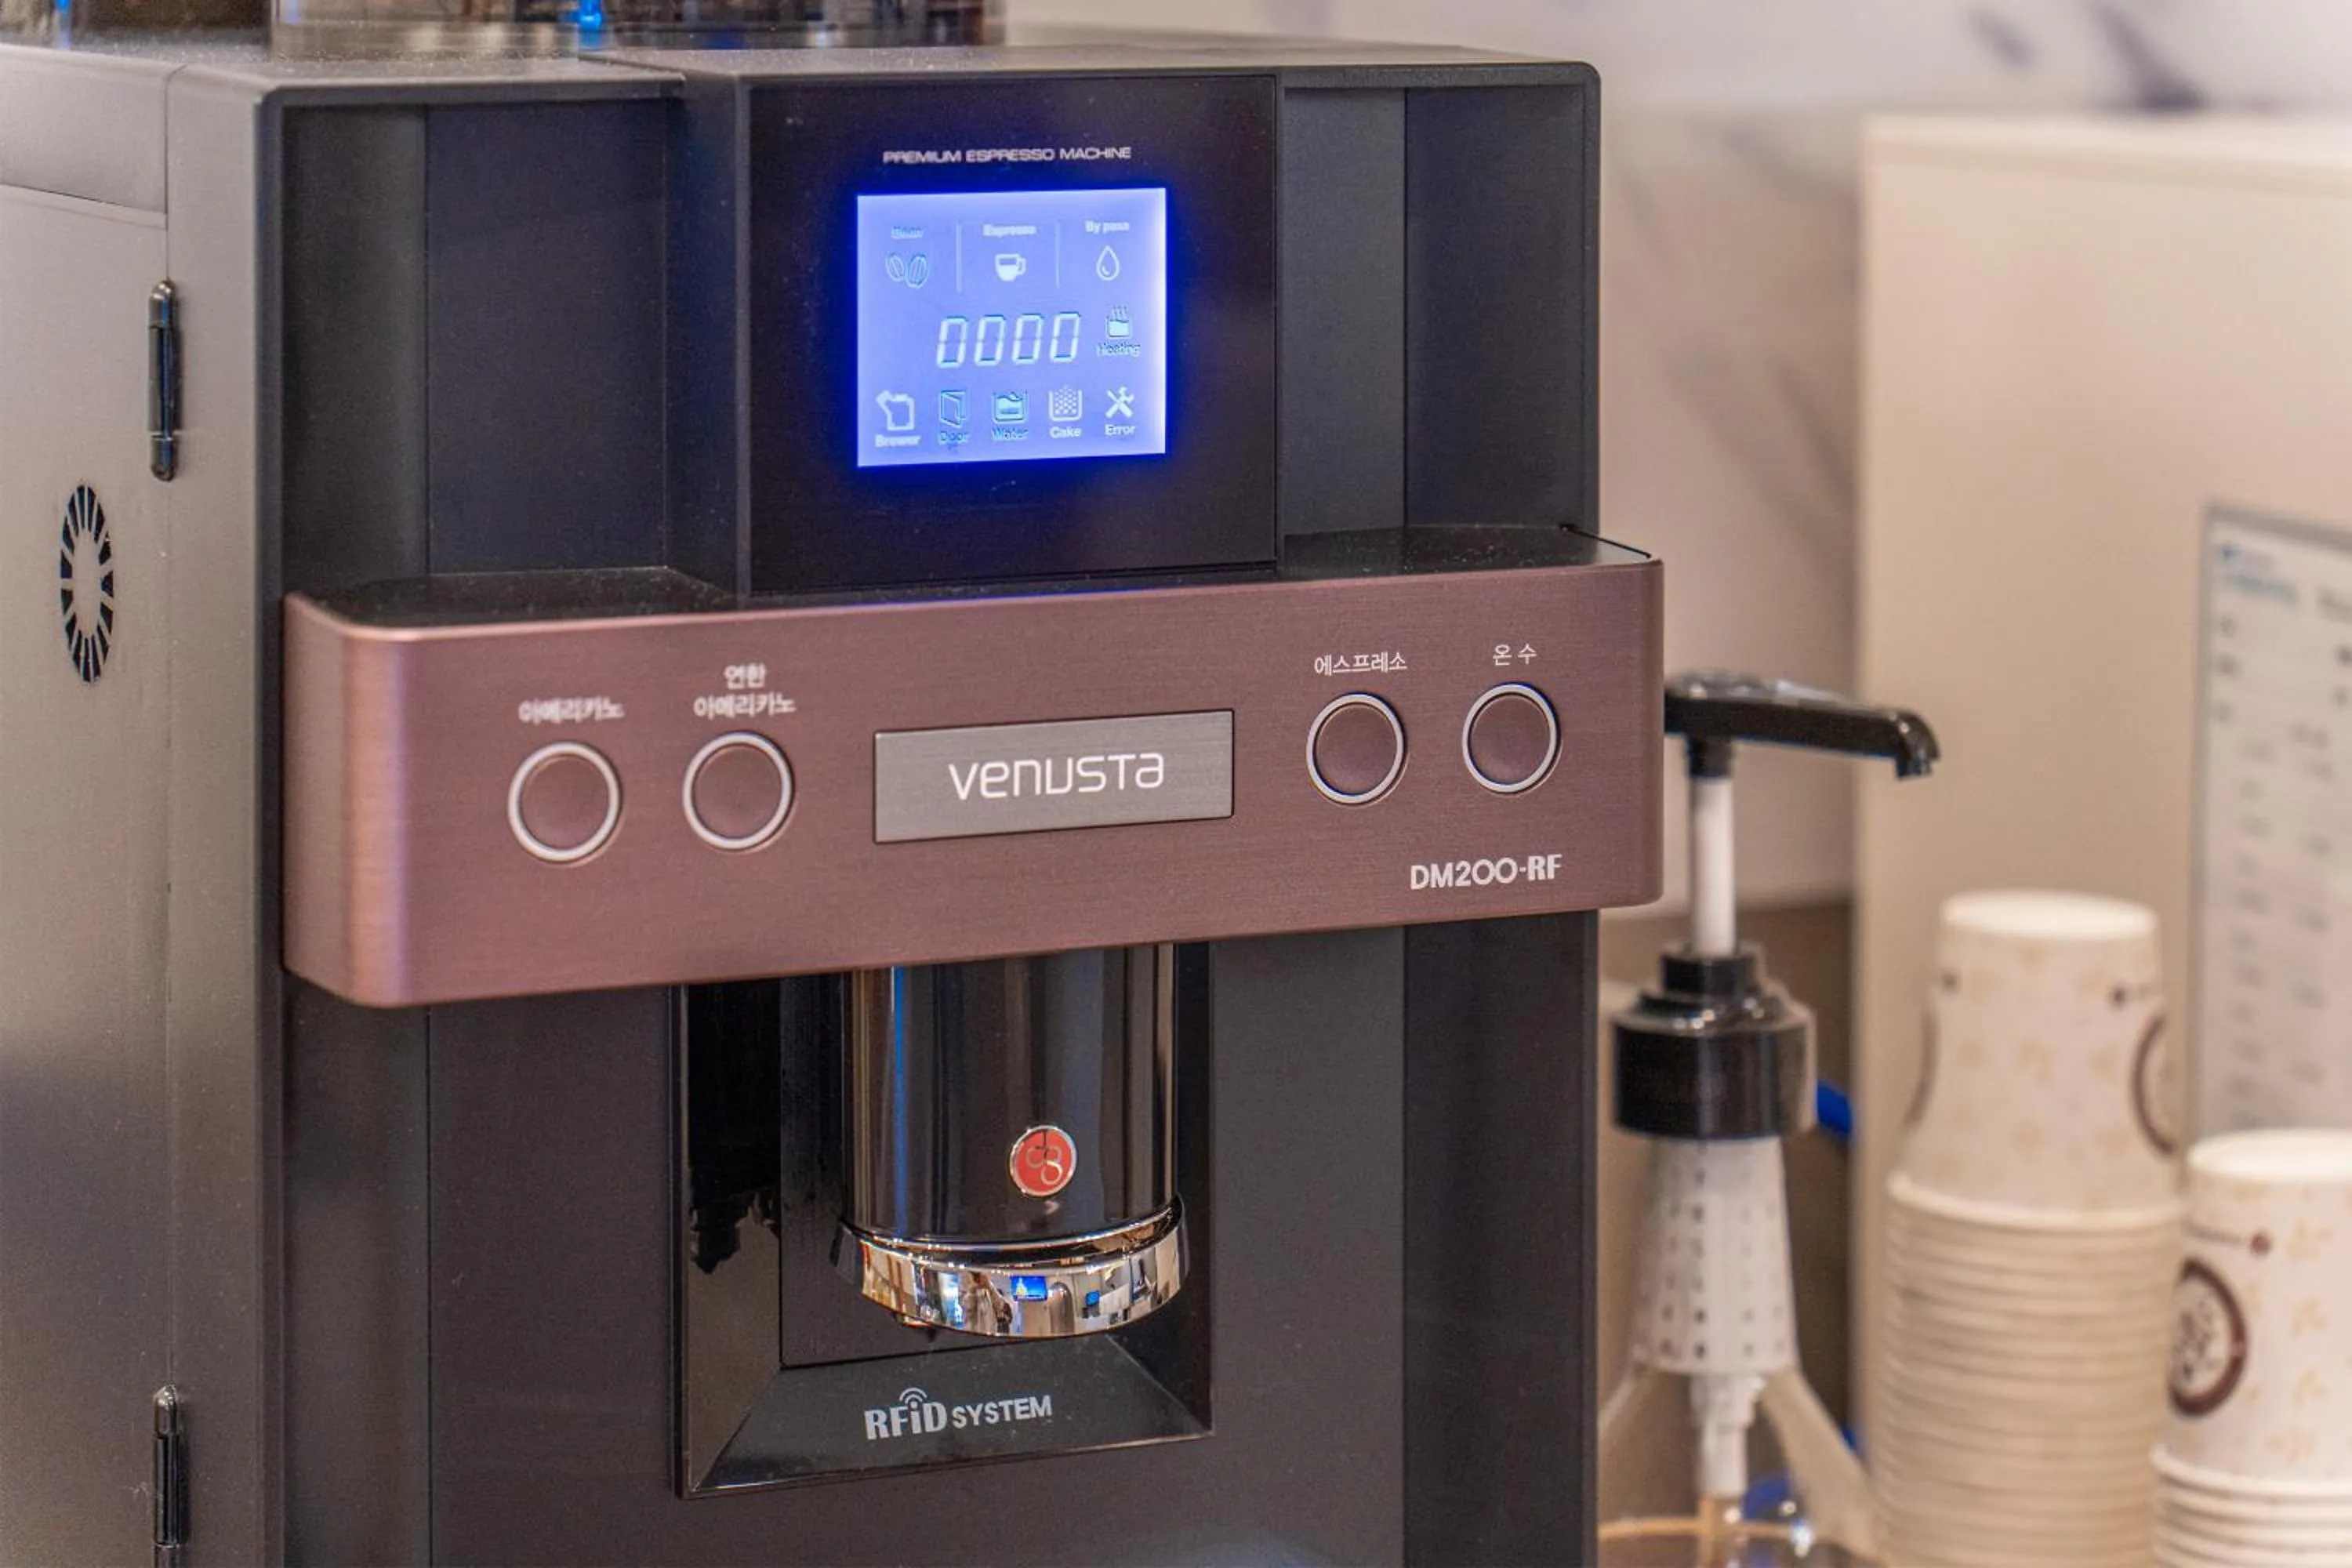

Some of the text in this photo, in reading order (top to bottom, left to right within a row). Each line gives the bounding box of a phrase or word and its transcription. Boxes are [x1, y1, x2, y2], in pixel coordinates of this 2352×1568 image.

[883, 147, 1132, 165] PREMIUM ESPRESSO MACHINE
[936, 311, 1081, 368] 0000
[1050, 425, 1083, 439] Cake
[1105, 423, 1136, 436] Error
[1313, 652, 1408, 677] 에스프레소
[1493, 643, 1537, 666] 온 수
[724, 663, 767, 690] 연한
[693, 691, 797, 720] 아메리카노
[1410, 854, 1563, 891] DM200-RF
[951, 1395, 1053, 1429] SYSTEM
